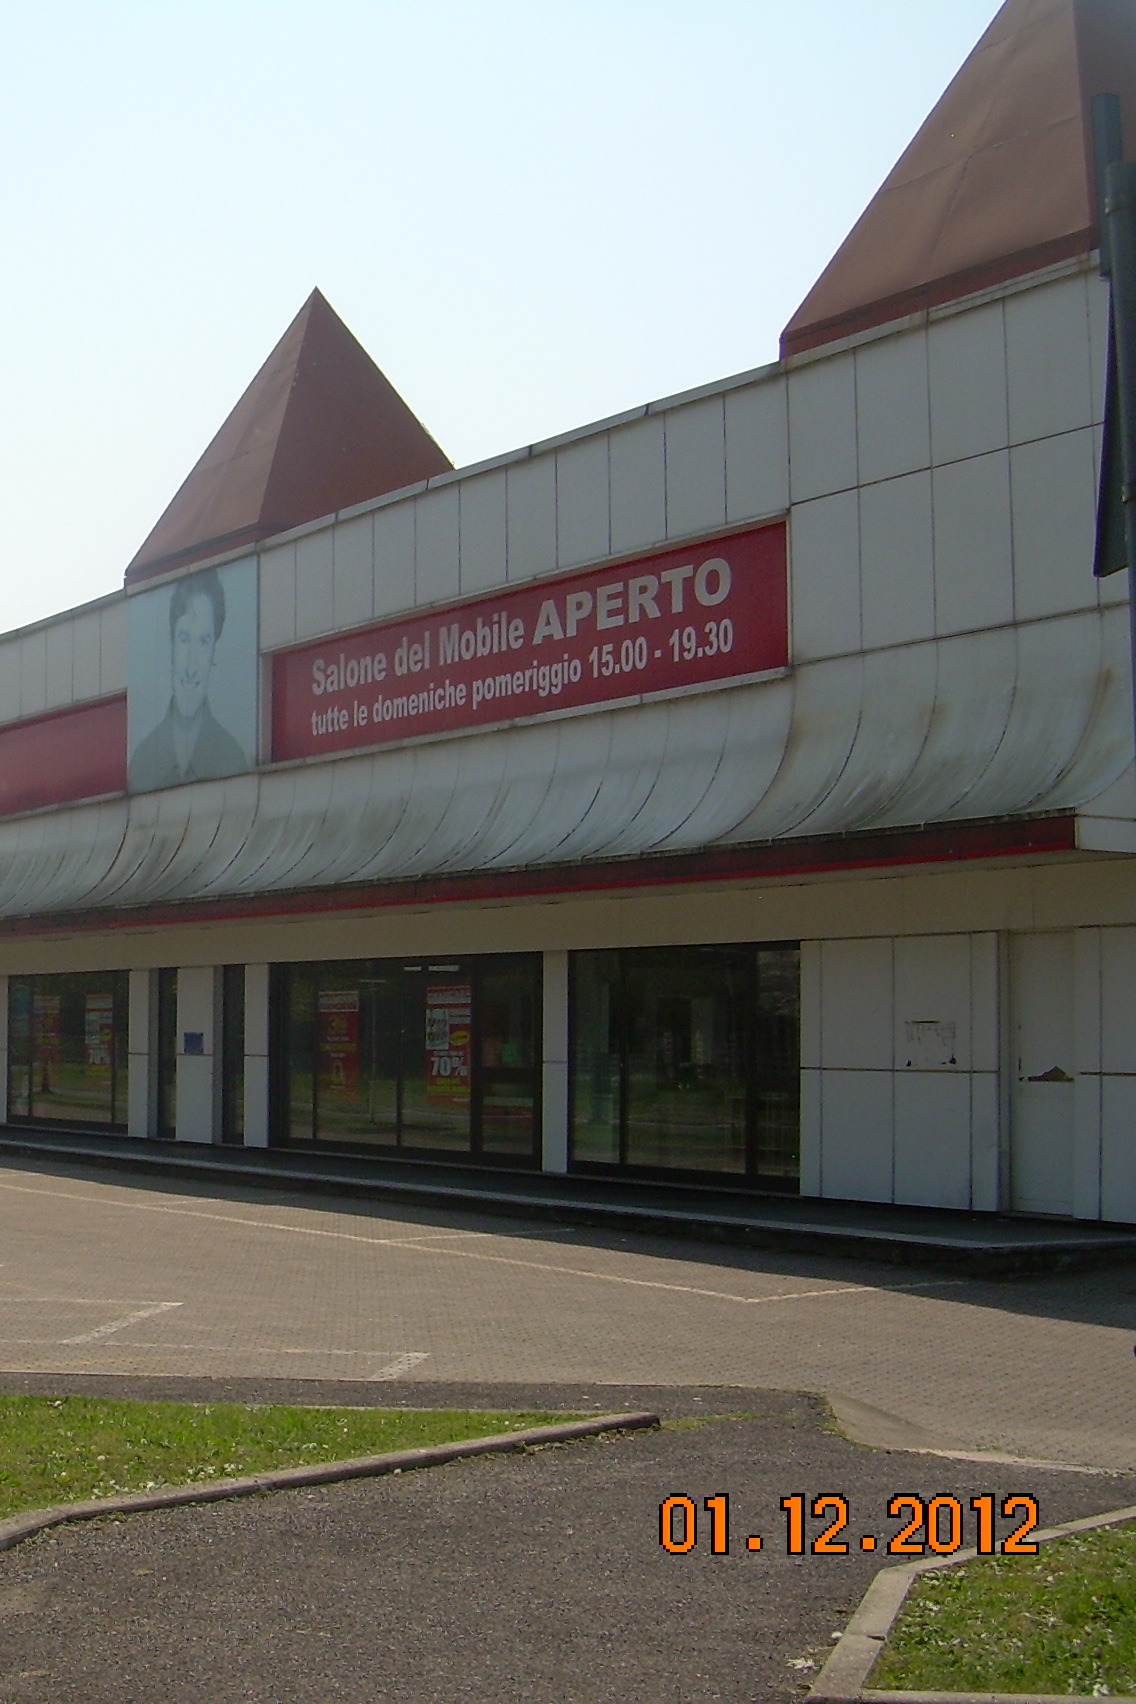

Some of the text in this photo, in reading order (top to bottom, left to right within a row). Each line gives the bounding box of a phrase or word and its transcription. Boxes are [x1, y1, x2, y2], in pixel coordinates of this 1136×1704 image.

[311, 700, 348, 737] tutte
[353, 700, 369, 726] le
[373, 677, 467, 724] domeniche
[472, 653, 582, 710] pomeriggio
[589, 636, 647, 678] 15.00
[669, 619, 734, 662] 19.30
[312, 557, 733, 696] Salone del Mobile APERTO
[431, 1056, 468, 1076] 70%
